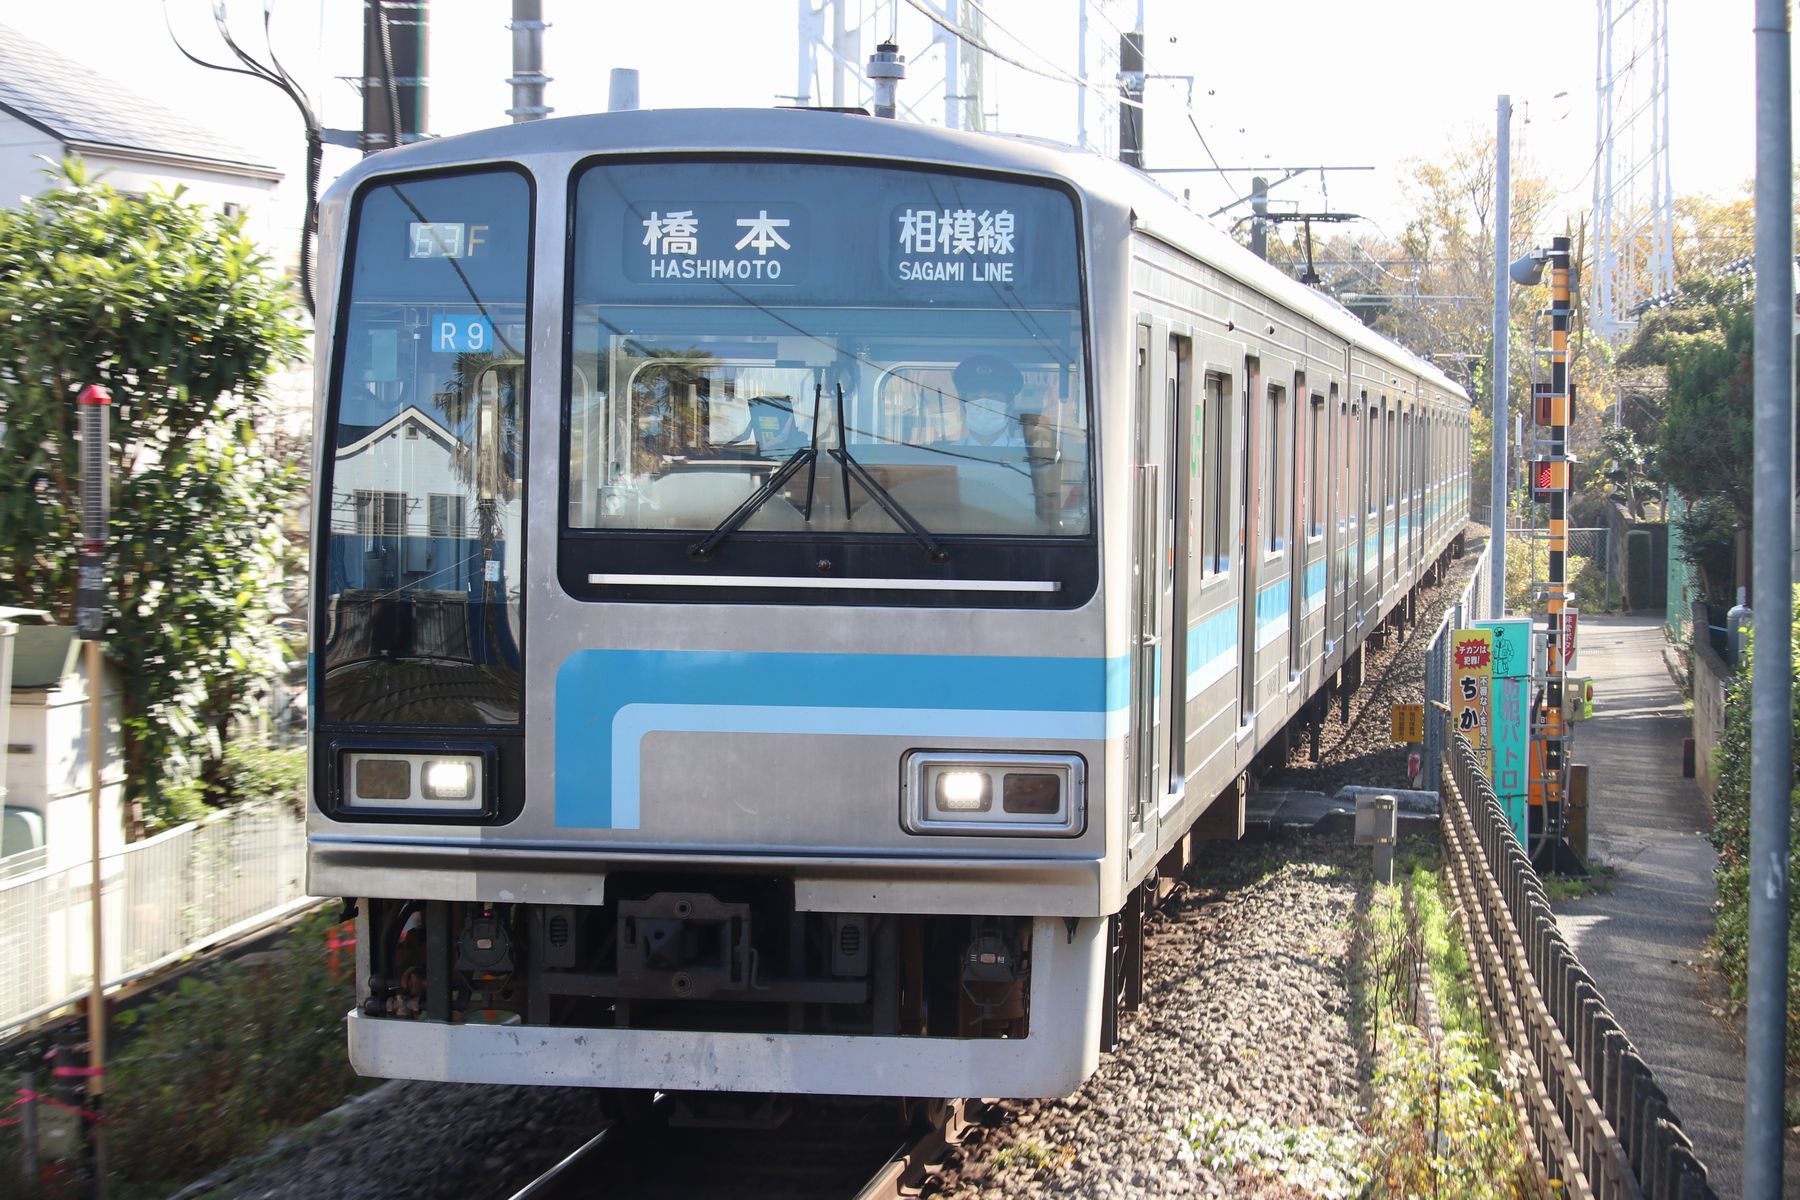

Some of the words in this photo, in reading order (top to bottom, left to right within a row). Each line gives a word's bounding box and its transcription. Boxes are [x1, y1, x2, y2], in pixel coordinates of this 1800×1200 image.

[642, 210, 791, 255] 橋本
[898, 208, 1015, 255] 相模線
[651, 259, 781, 279] HASHIMOTO
[899, 261, 964, 281] SAGAMI
[972, 262, 1013, 282] LINE
[1459, 646, 1487, 655] チカンは
